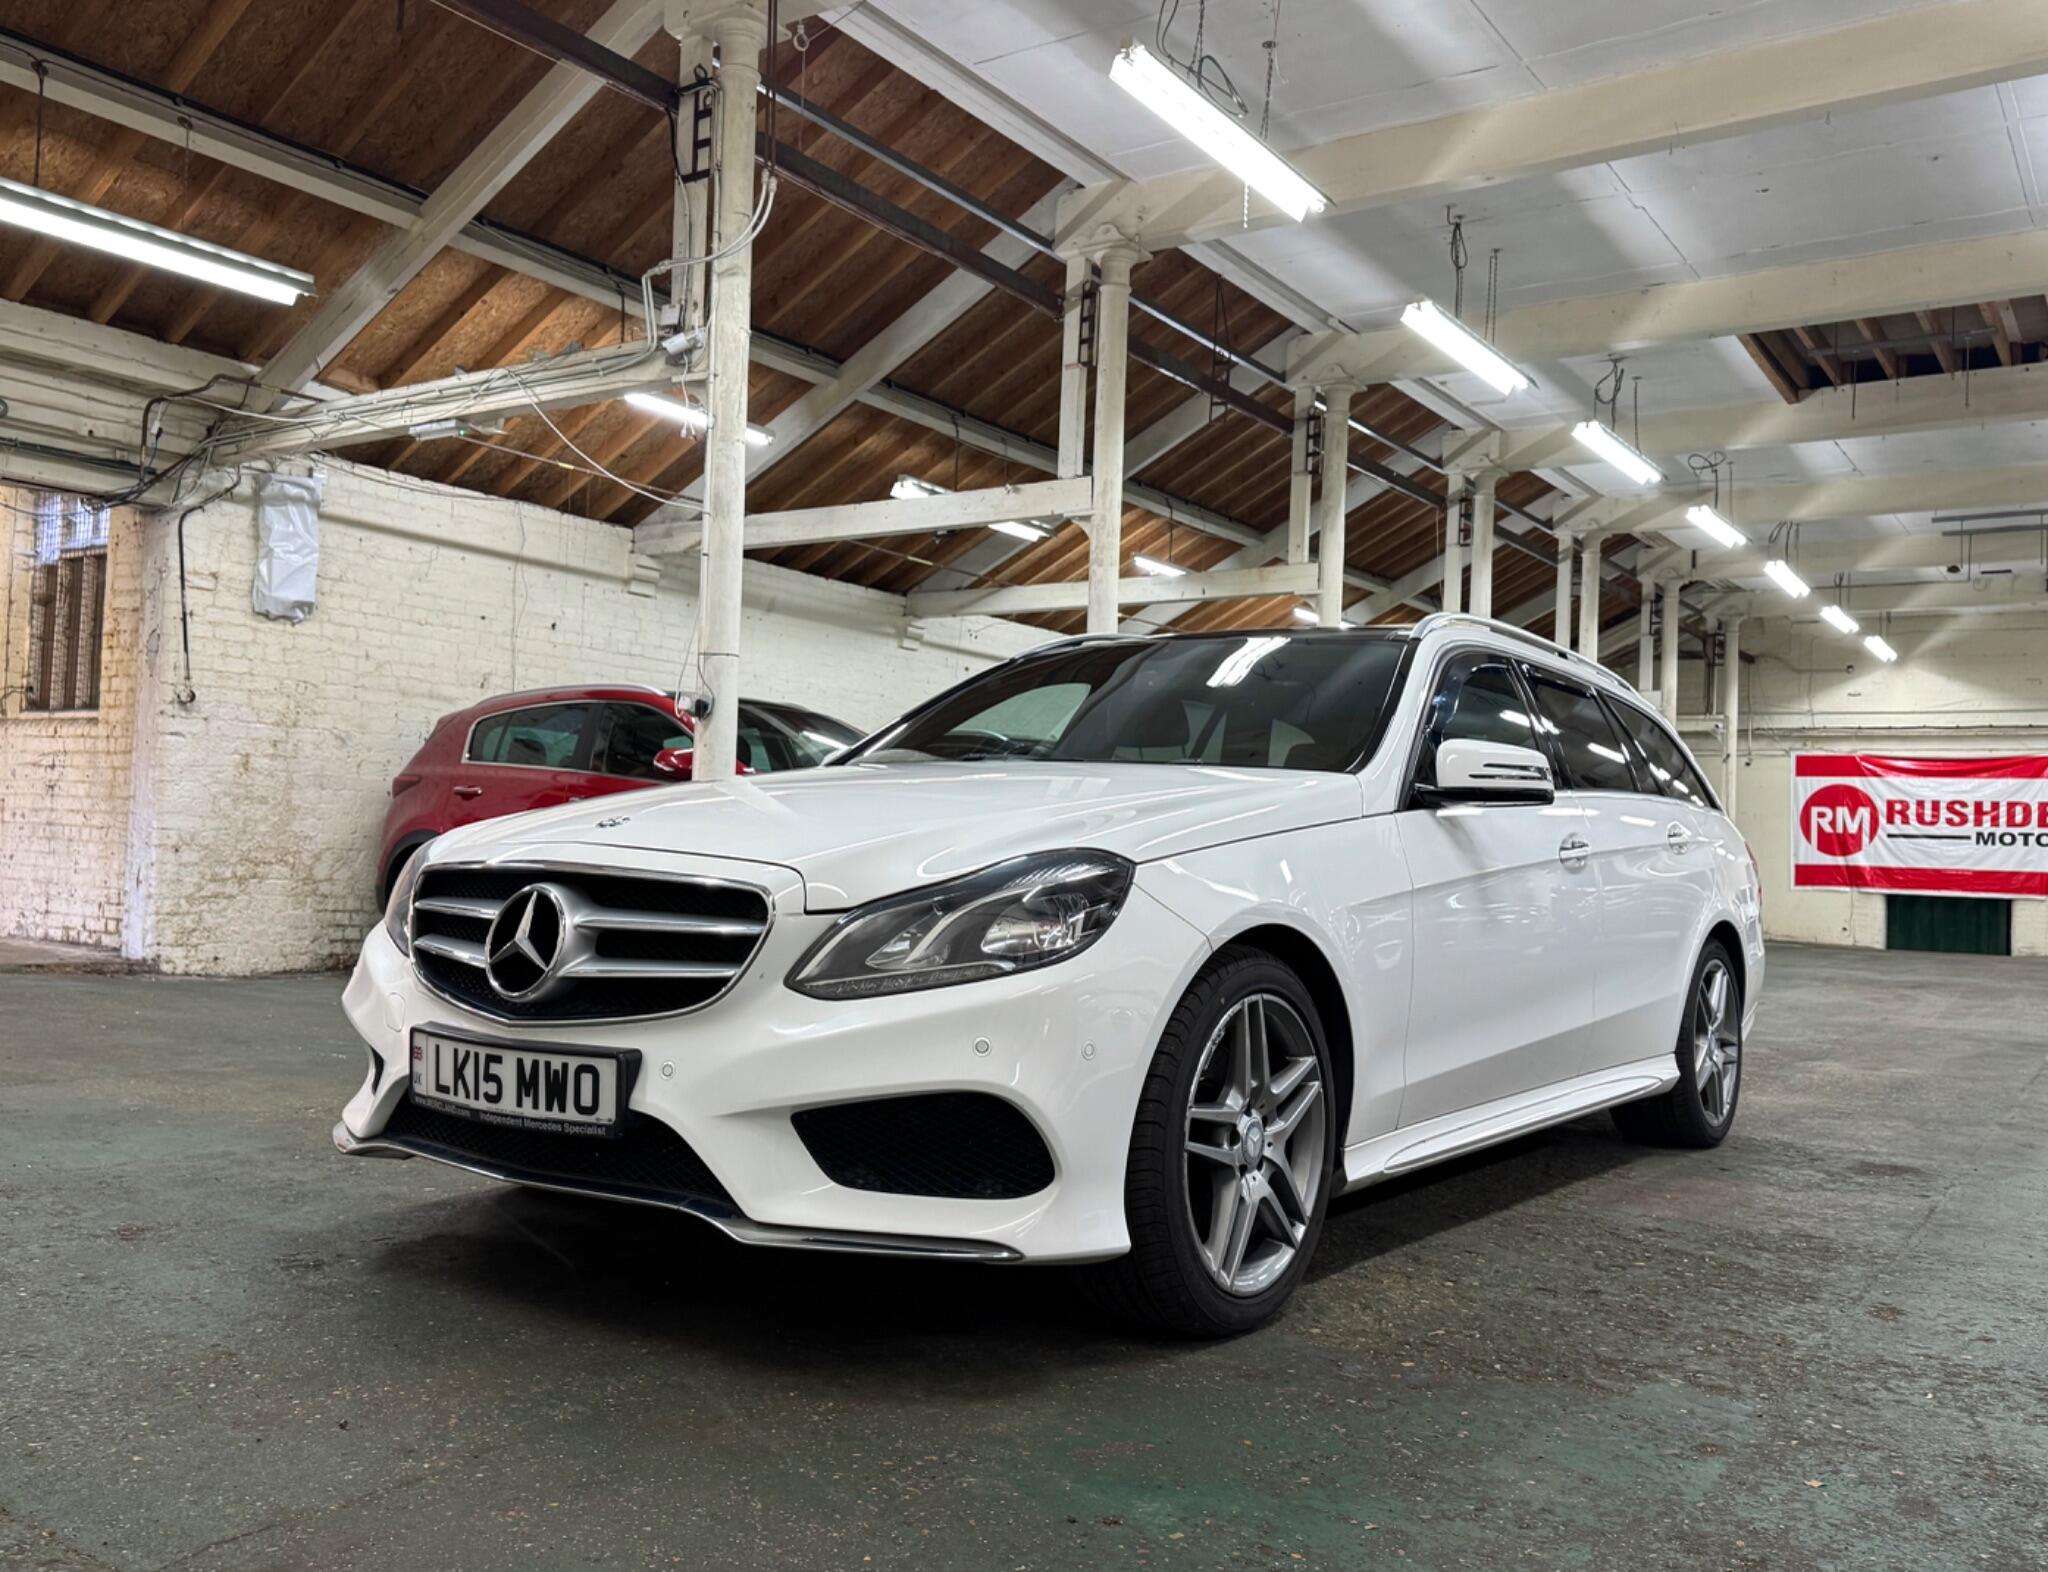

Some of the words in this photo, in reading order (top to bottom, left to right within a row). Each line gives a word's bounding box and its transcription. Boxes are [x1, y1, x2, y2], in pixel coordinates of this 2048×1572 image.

[1810, 806, 1871, 848] RM
[1975, 831, 2048, 847] MOTO
[434, 1043, 503, 1104] LK15
[515, 1057, 600, 1115] MWO
[563, 1122, 606, 1136] Specialist
